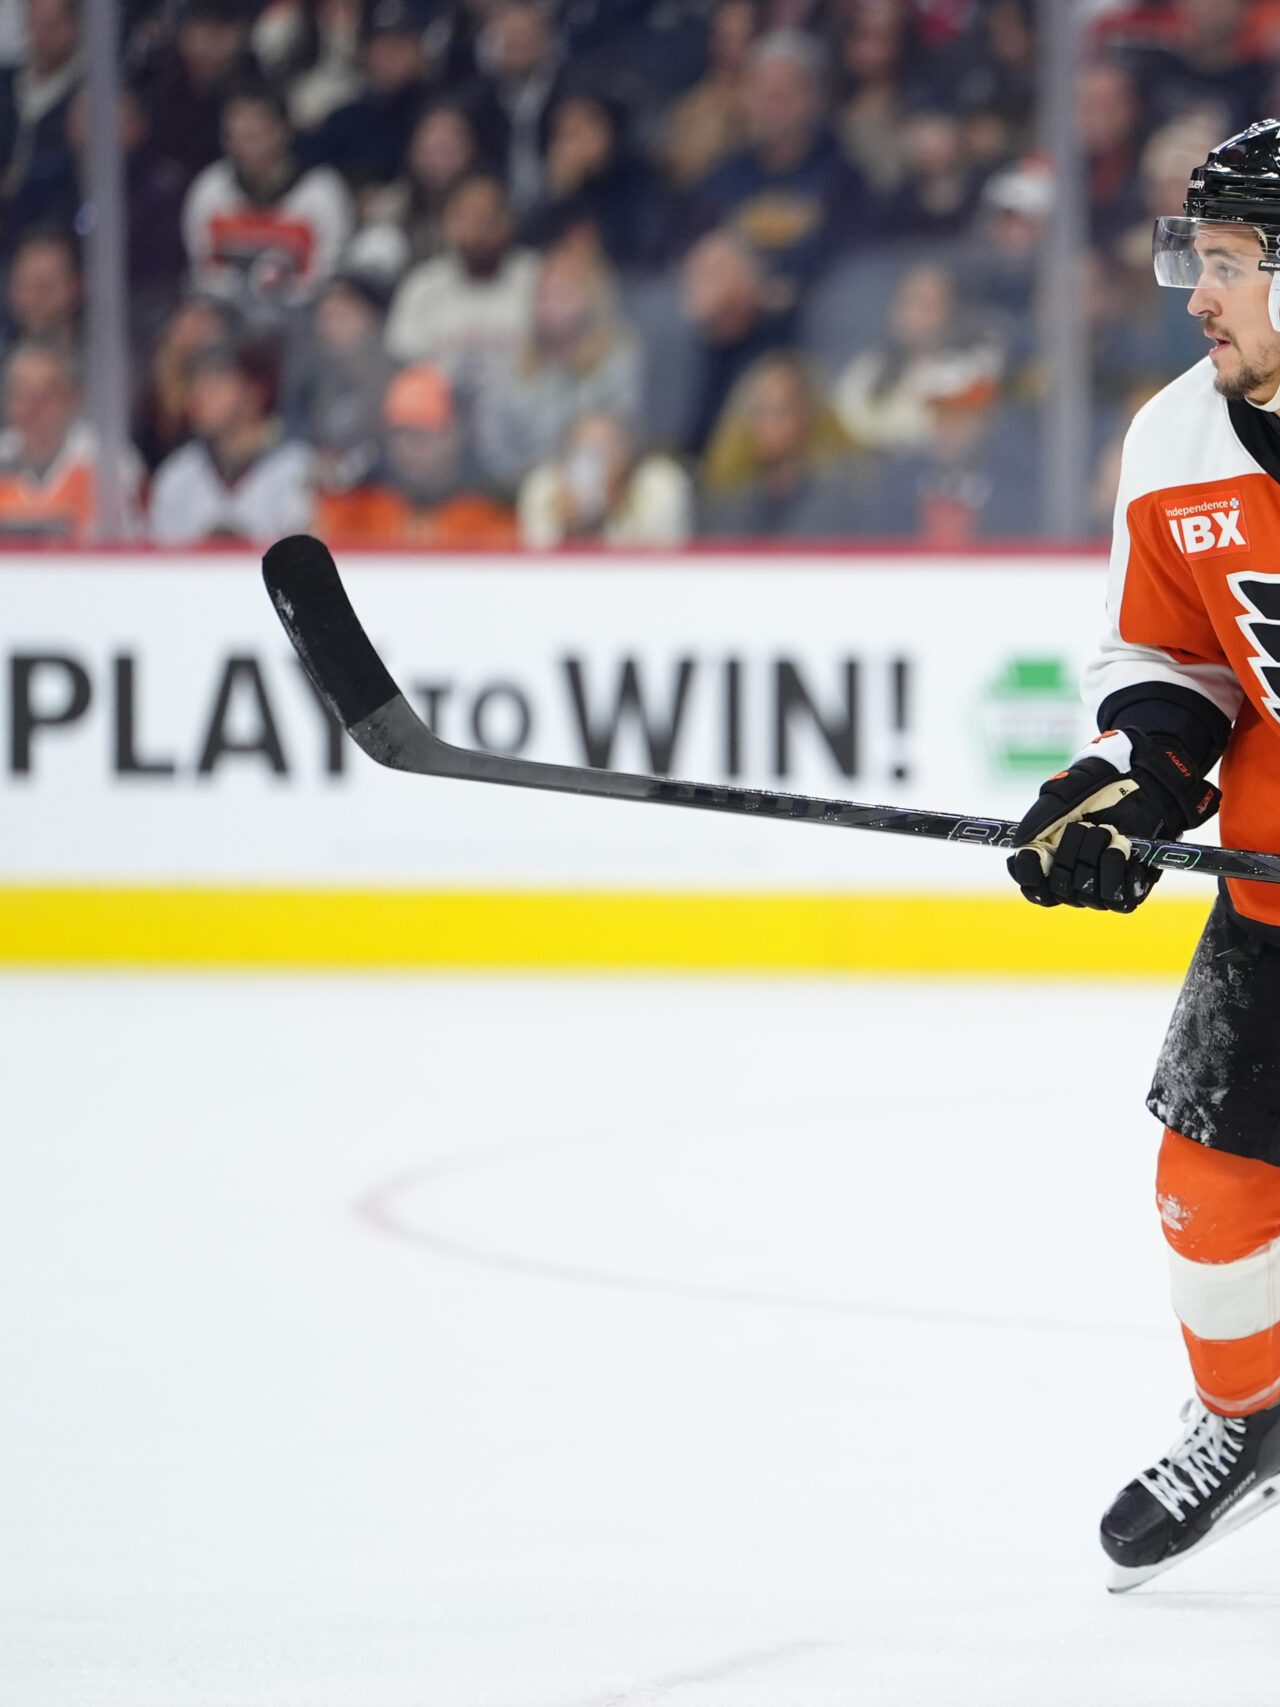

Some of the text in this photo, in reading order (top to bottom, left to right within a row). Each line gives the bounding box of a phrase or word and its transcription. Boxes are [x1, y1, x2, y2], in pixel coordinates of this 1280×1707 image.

[1165, 501, 1229, 517] Independence
[1168, 510, 1247, 554] IBX
[9, 653, 911, 781] PLAY TO WIN!
